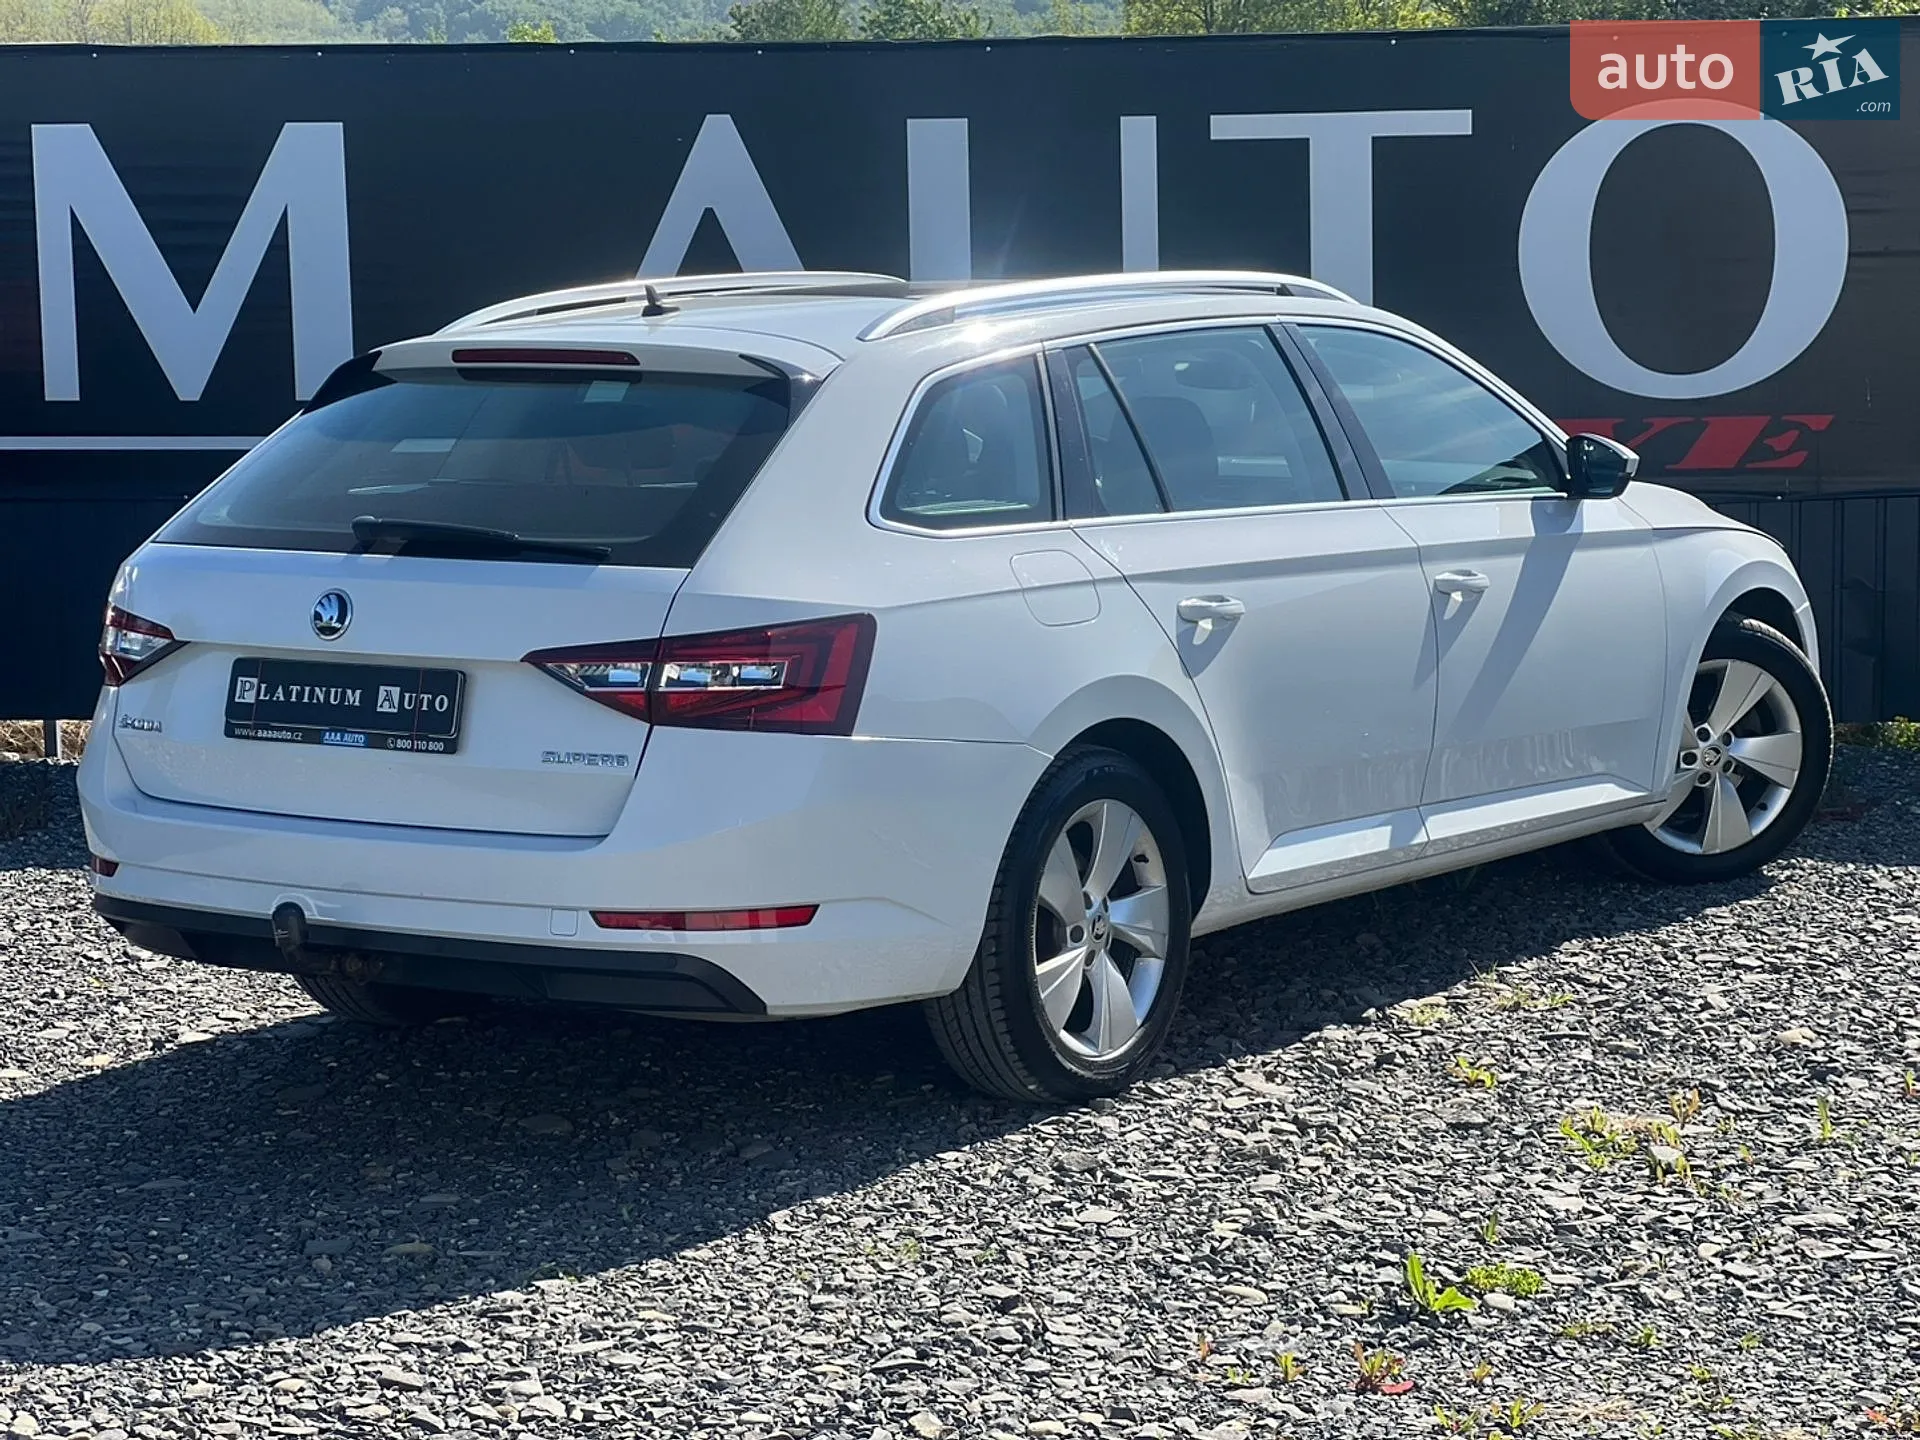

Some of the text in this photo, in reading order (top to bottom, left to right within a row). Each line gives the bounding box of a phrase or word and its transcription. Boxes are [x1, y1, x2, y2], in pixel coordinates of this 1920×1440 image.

[31, 122, 354, 401] M
[235, 677, 449, 713] PLATINUM AUTO
[323, 732, 364, 744] AAA AUTO
[396, 738, 412, 750] 800
[427, 741, 444, 752] 800
[541, 750, 630, 767] SUPERB
